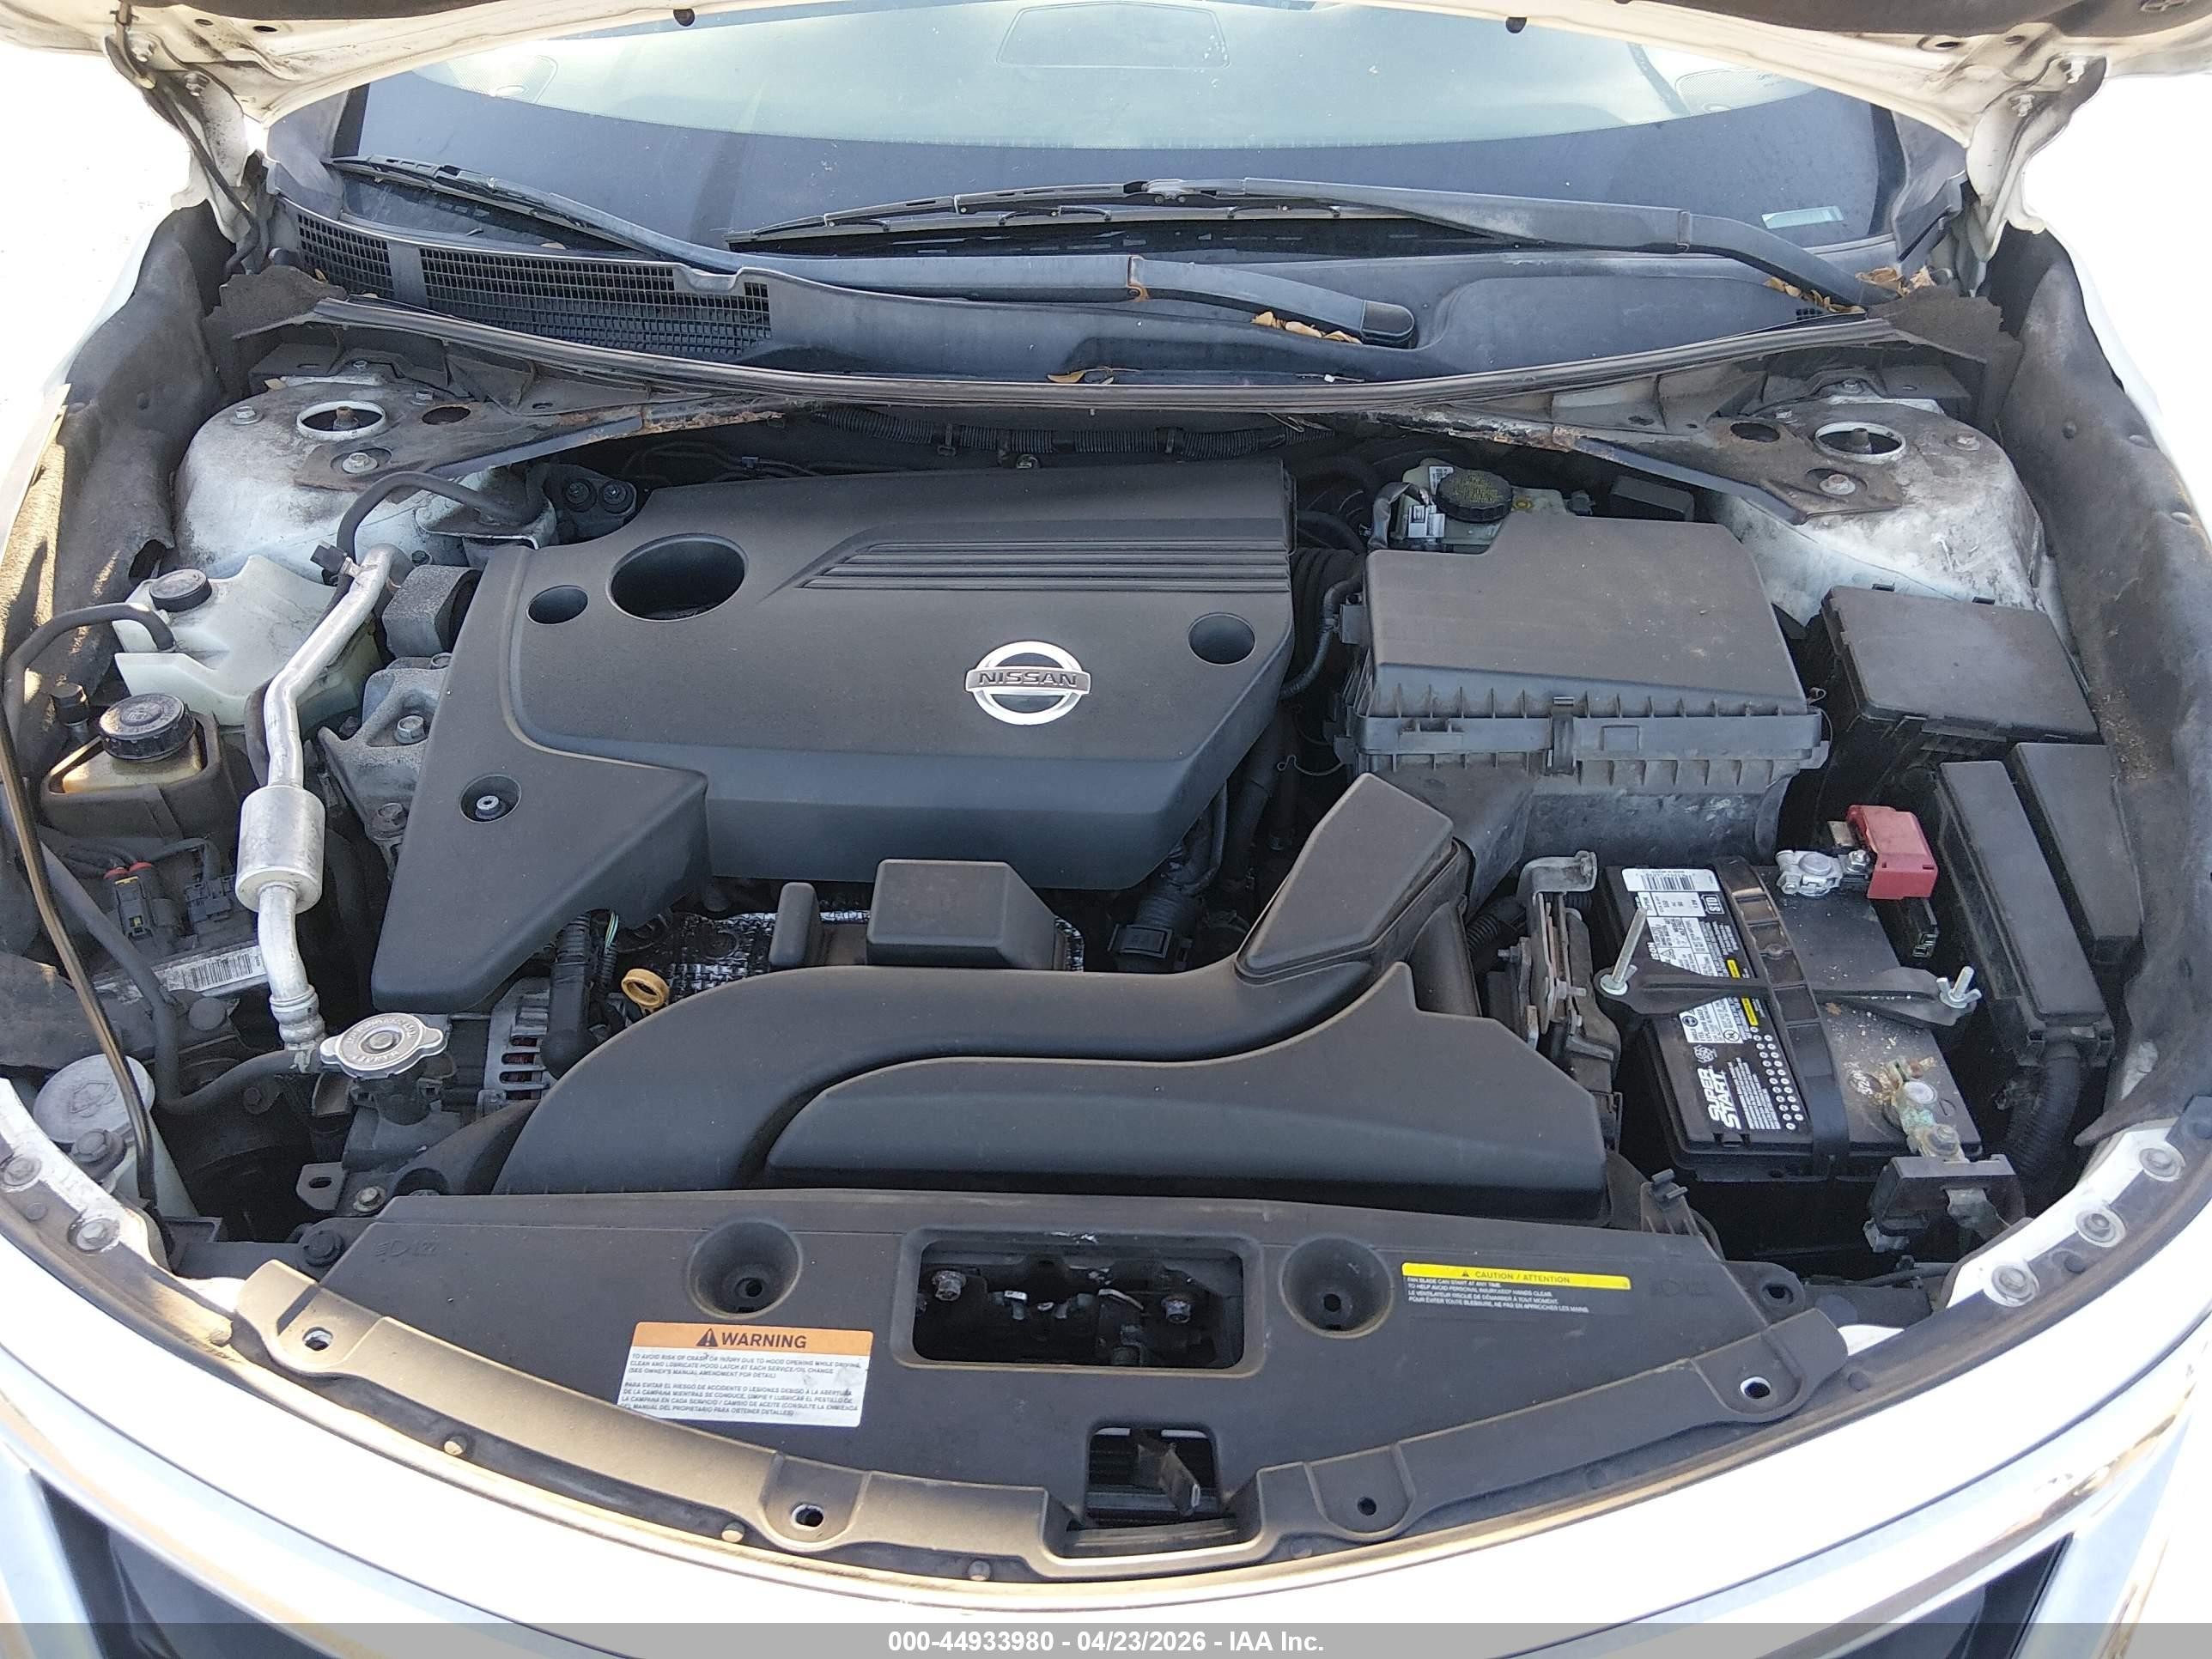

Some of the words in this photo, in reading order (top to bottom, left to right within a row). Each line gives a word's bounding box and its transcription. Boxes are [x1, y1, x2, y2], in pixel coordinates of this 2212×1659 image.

[978, 671, 1079, 689] NISSAN
[1705, 896, 1721, 911] STD
[1697, 1067, 1720, 1121] SUPER
[1708, 1068, 1742, 1130] START
[1475, 1271, 1512, 1279] CAUTION
[1522, 1274, 1570, 1283] ATTENTION
[720, 1332, 808, 1348] WARNING
